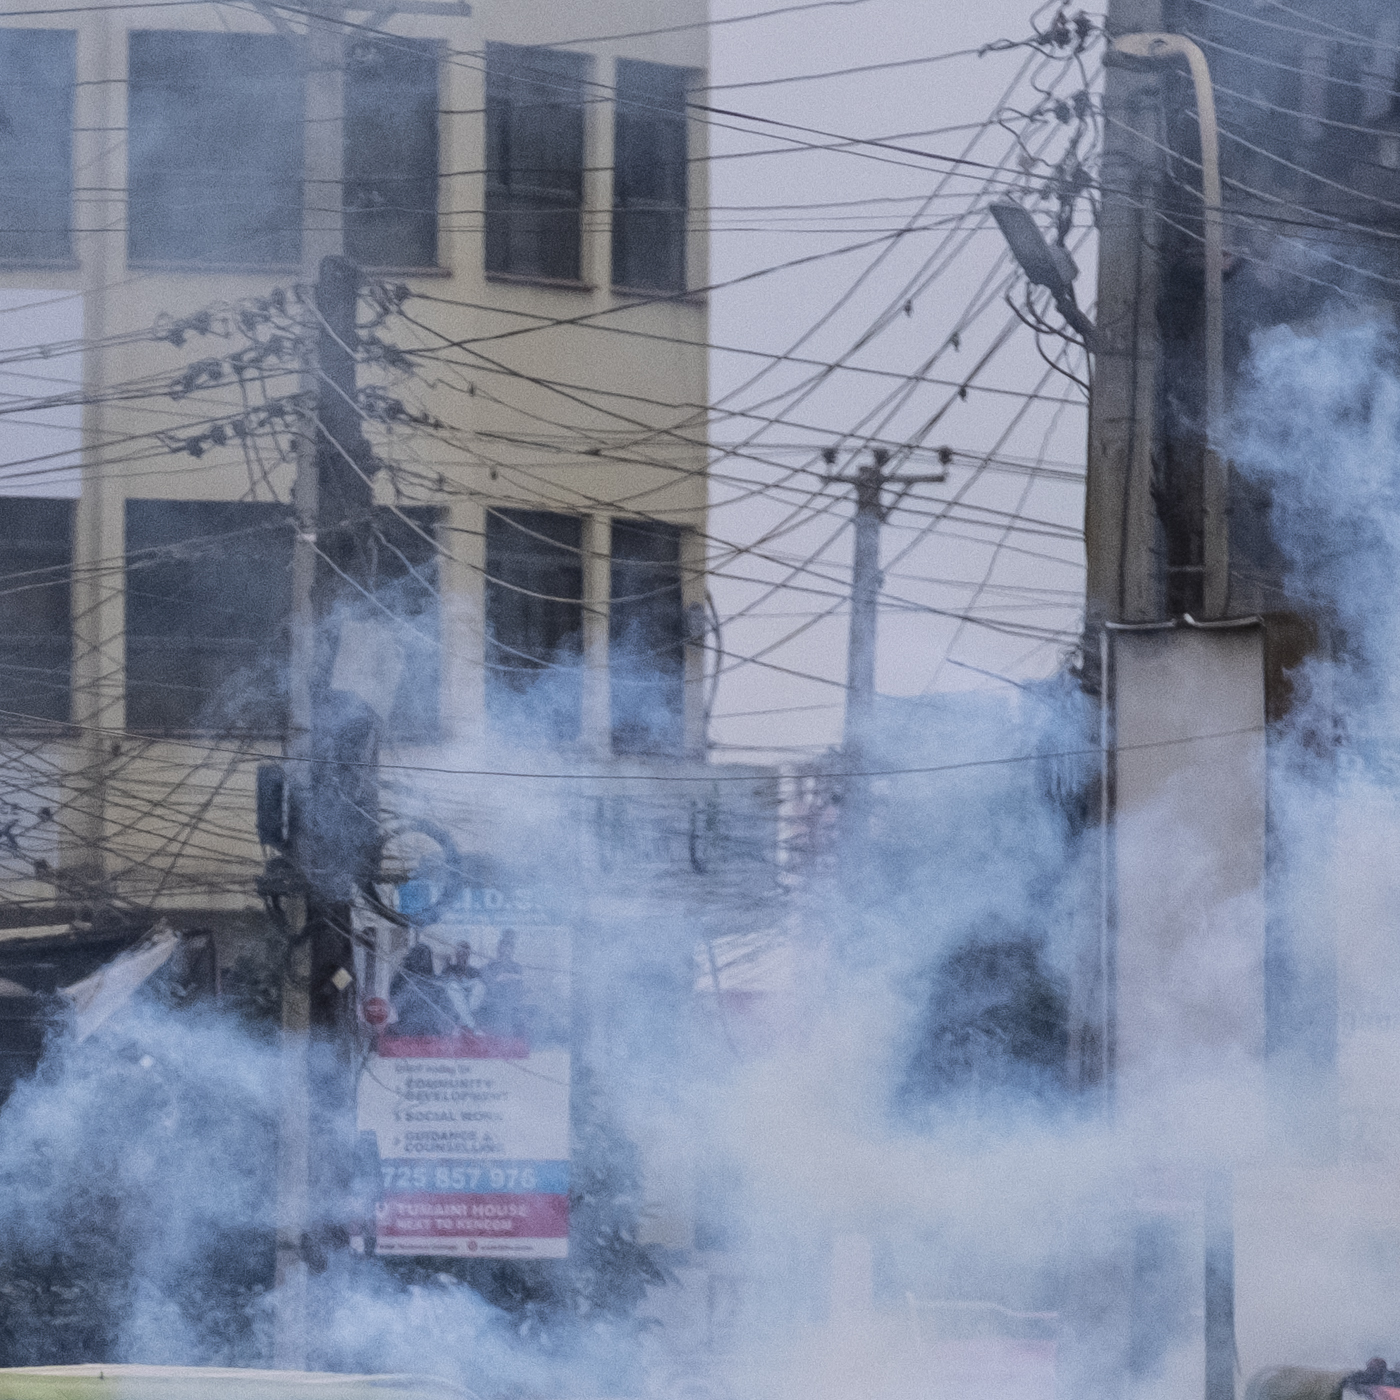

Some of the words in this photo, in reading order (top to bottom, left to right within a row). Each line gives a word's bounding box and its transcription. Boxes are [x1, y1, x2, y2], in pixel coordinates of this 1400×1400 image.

[405, 1077, 496, 1090] COMMUNITY
[404, 1090, 508, 1102] DEVELOPMENT
[404, 1110, 457, 1122] SOCIAL
[404, 1130, 477, 1142] GUIDANCE
[434, 1166, 481, 1189] 857
[489, 1167, 538, 1190] 976
[396, 1202, 469, 1217] TUMAINI
[471, 1203, 528, 1217] HOUSE
[395, 1217, 431, 1230] NEXT
[435, 1218, 453, 1230] TO
